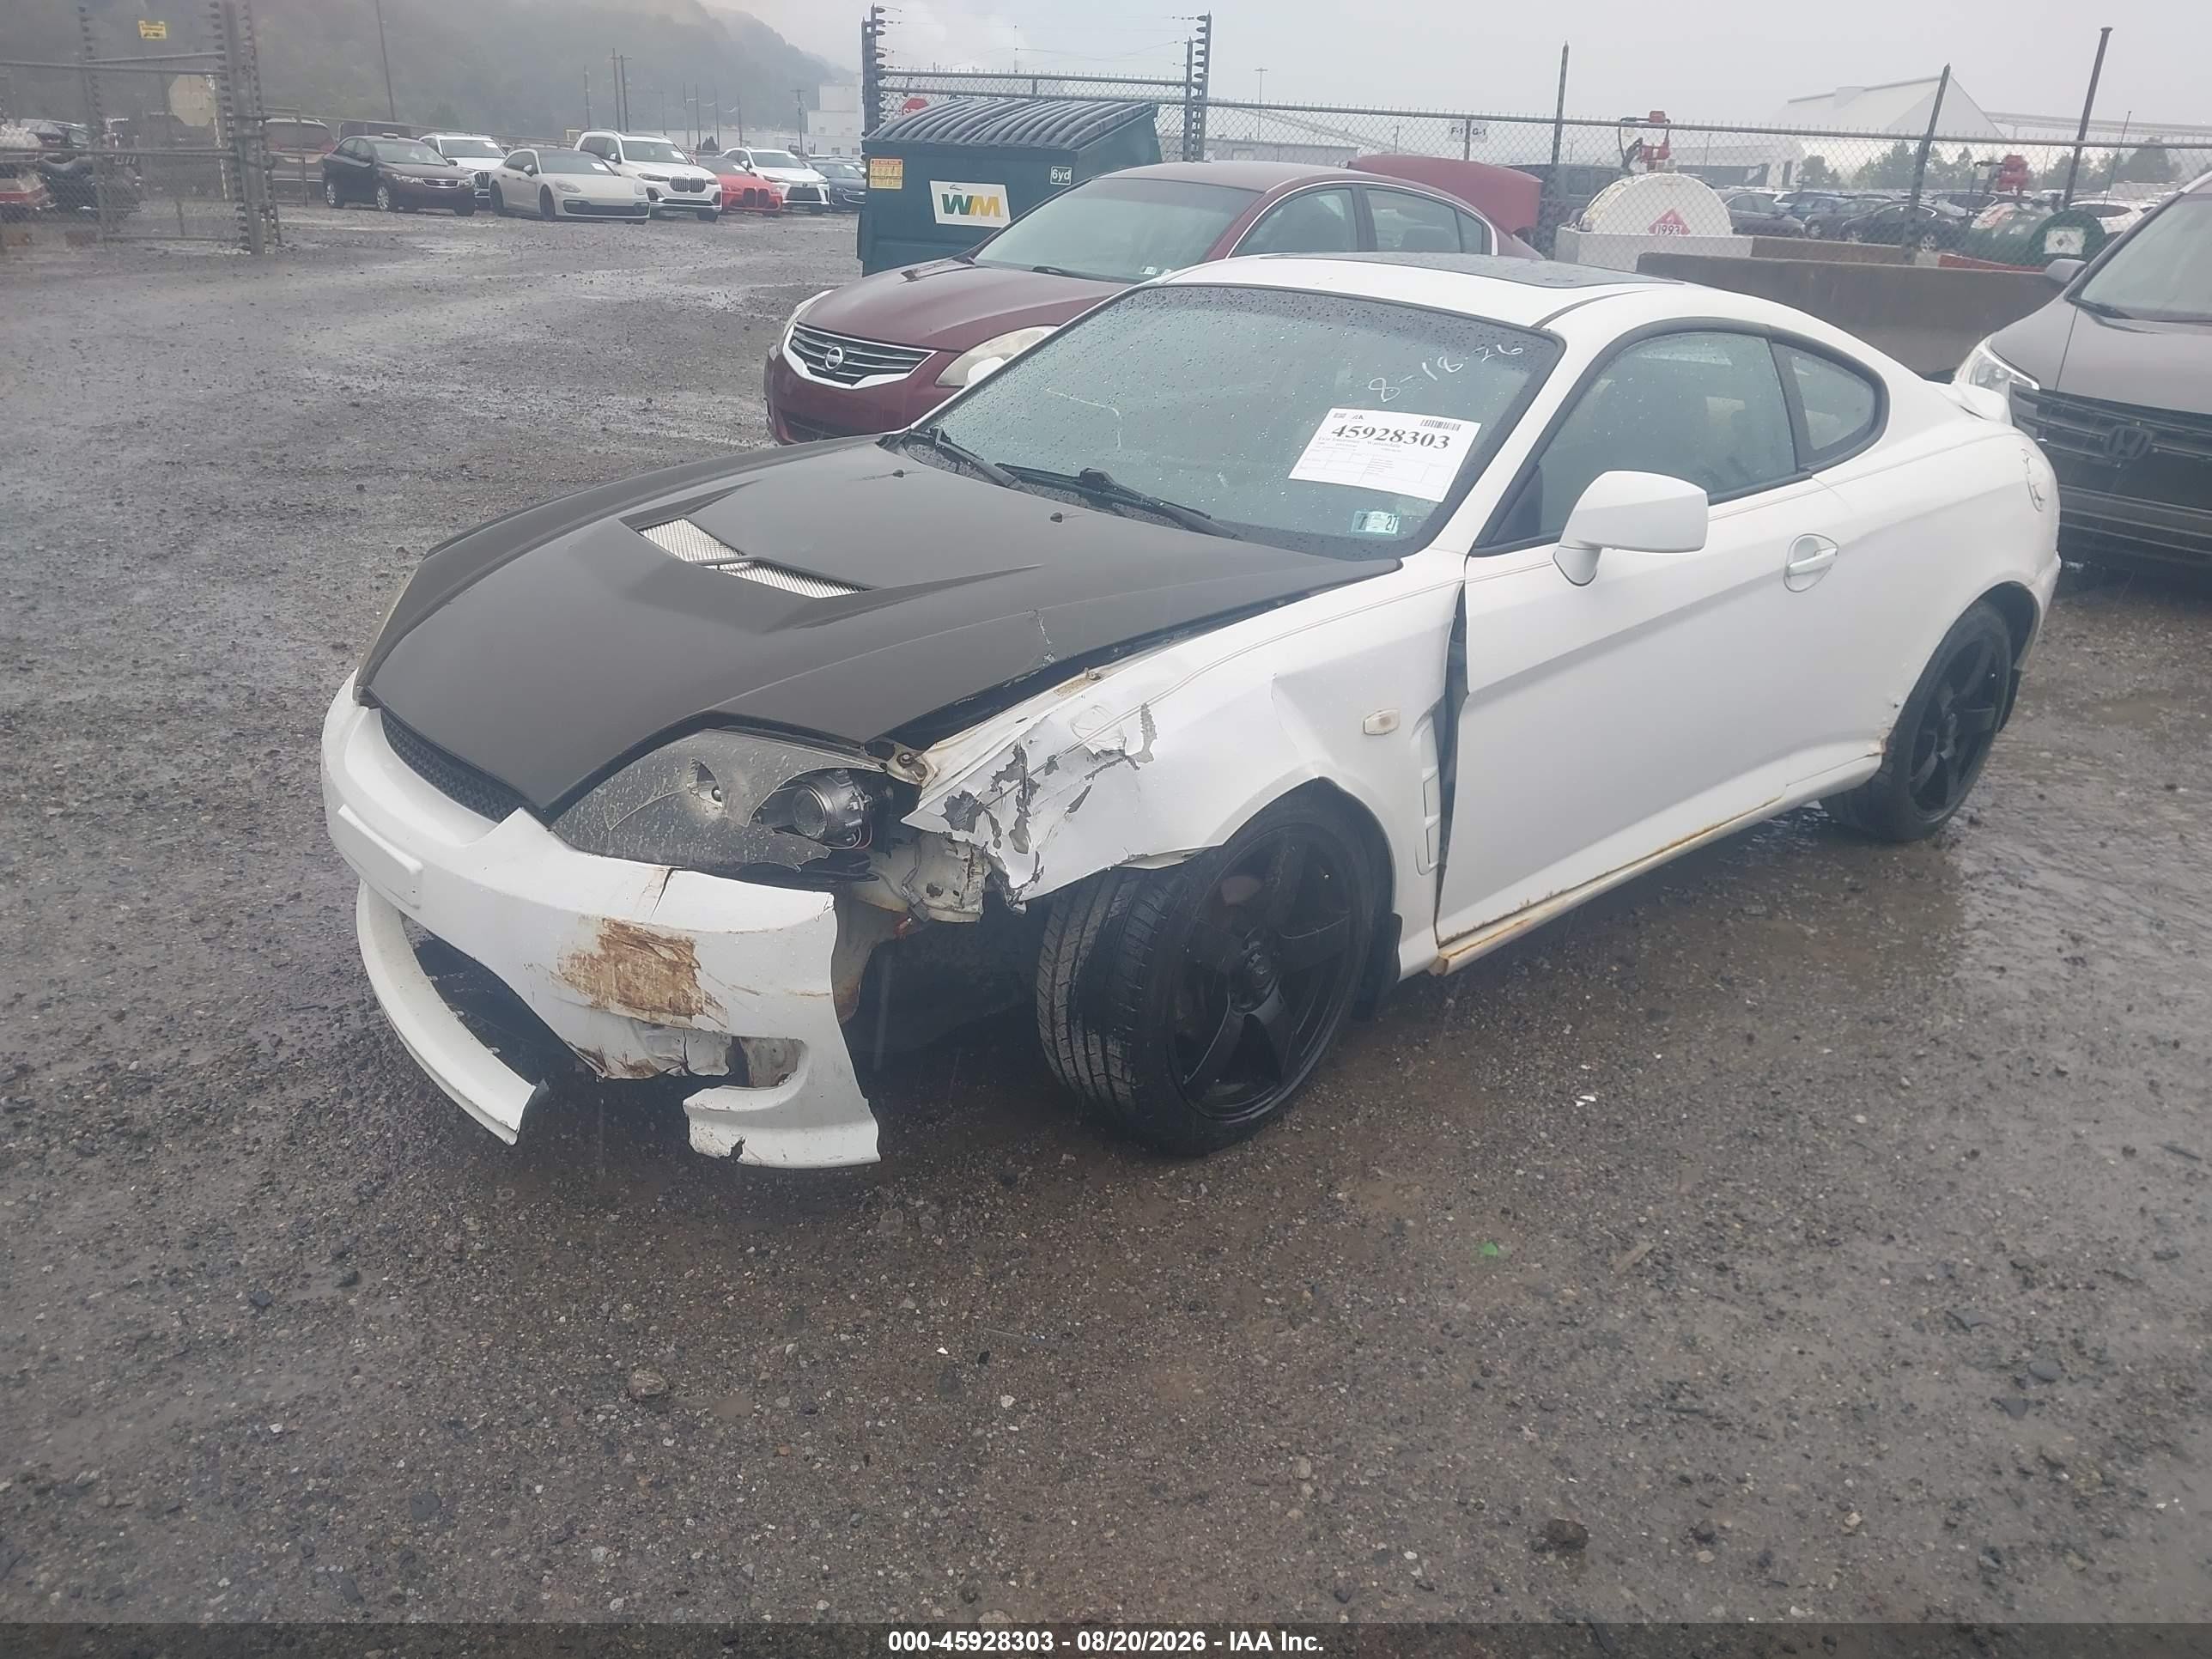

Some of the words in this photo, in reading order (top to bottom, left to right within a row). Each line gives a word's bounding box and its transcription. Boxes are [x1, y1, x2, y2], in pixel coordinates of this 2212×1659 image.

[1051, 168, 1072, 182] 6yd
[941, 193, 1001, 217] WM
[1657, 225, 1680, 235] 1993
[1332, 424, 1450, 451] 45928303
